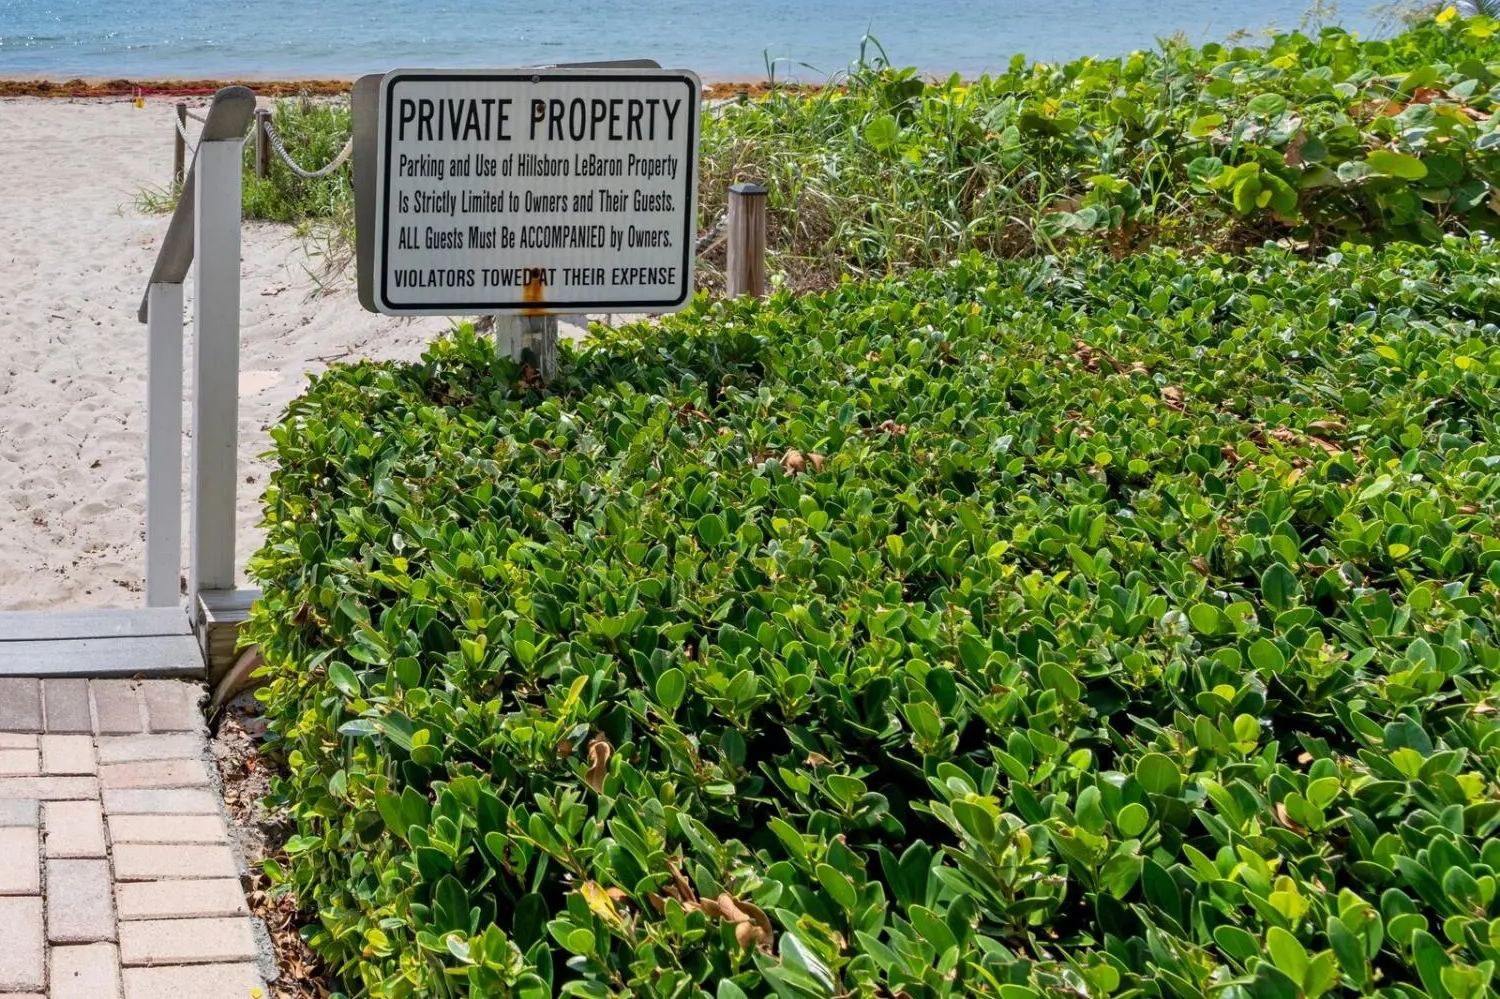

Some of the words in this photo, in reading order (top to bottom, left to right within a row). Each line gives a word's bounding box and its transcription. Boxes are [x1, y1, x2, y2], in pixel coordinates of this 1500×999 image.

[398, 98, 512, 141] PRIVATE
[530, 98, 681, 141] PROPERTY
[399, 154, 445, 180] Parking
[450, 154, 470, 177] and
[475, 154, 496, 177] Use
[502, 153, 513, 177] of
[517, 154, 569, 177] Hillsboro
[574, 154, 623, 177] LeBaron
[628, 154, 678, 180] Property
[398, 190, 409, 213] Is
[413, 190, 457, 217] Strictly
[461, 190, 504, 213] Limited
[509, 192, 520, 212] to
[525, 190, 568, 213] Owners
[573, 189, 593, 212] and
[599, 189, 628, 212] Their
[633, 189, 675, 212] Guests.
[398, 226, 420, 250] ALL
[425, 226, 463, 250] Guests
[468, 226, 496, 249] Must
[501, 226, 515, 249] Be
[519, 225, 605, 249] ACCOMPANIED
[610, 225, 623, 252] by
[628, 225, 672, 249] Owners.
[394, 269, 475, 288] VIOLATORS
[482, 268, 532, 287] TOWED
[539, 268, 556, 286] AT
[563, 268, 605, 286] THEIR
[612, 267, 676, 286] EXPENSE
